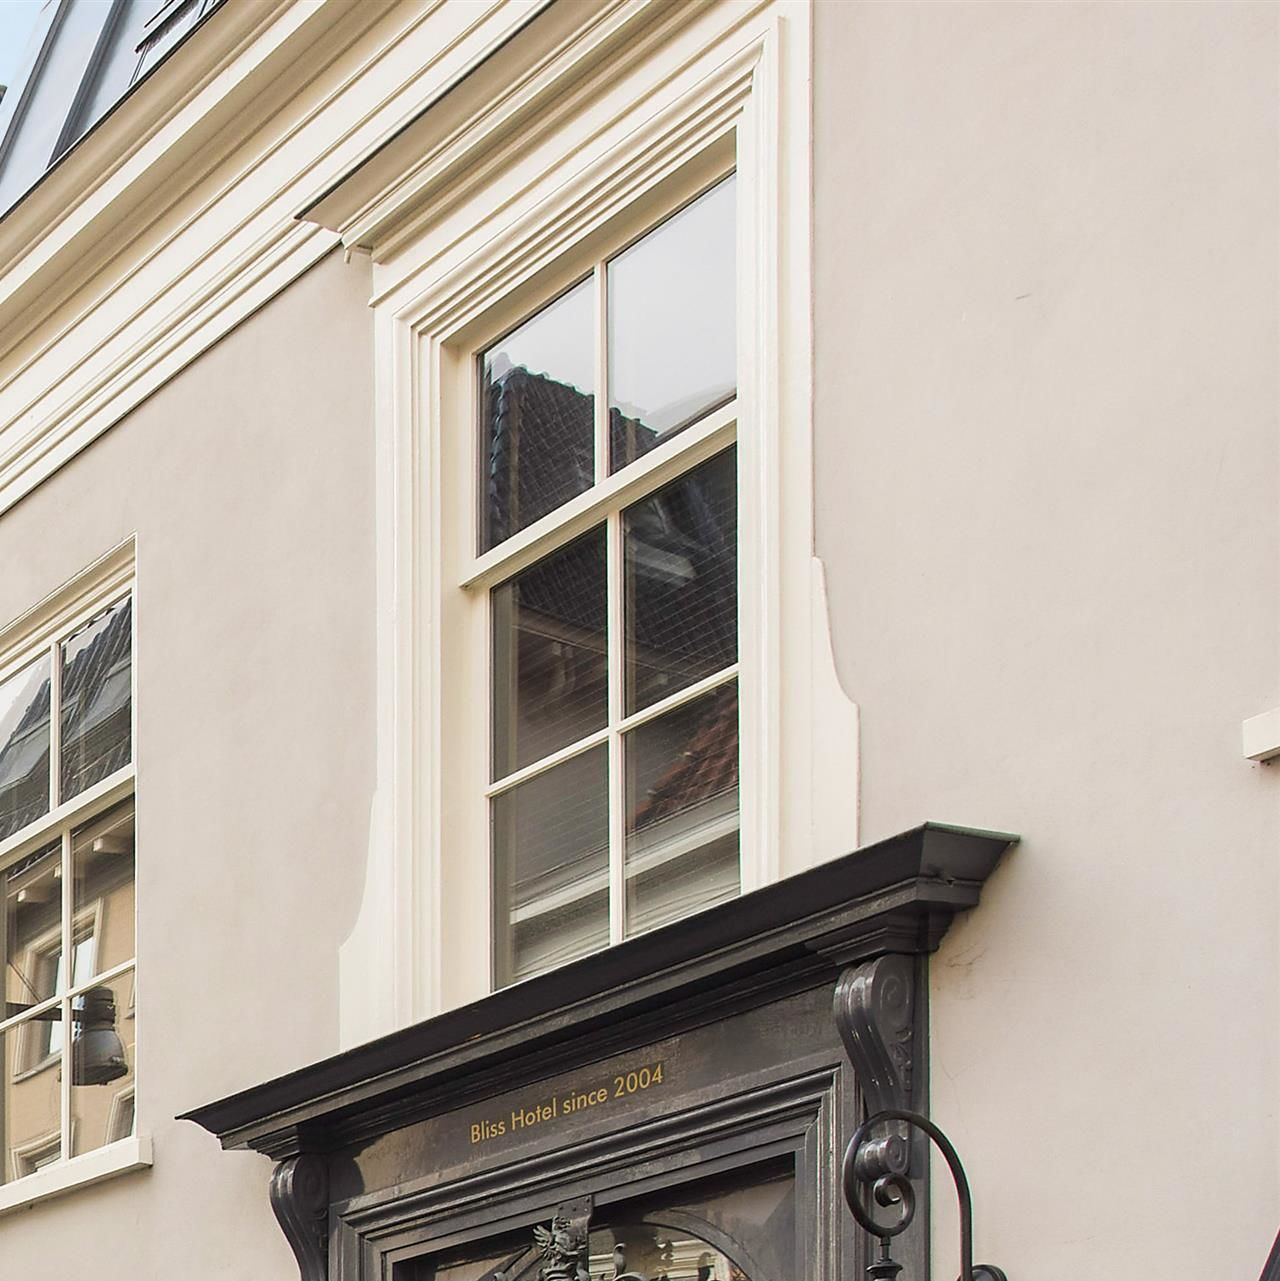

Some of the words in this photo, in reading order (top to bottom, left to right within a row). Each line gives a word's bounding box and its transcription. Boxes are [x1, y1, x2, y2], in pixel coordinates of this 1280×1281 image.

[470, 1119, 506, 1144] Bliss
[511, 1097, 557, 1131] Hotel
[563, 1087, 608, 1114] since
[614, 1063, 664, 1098] 2004
